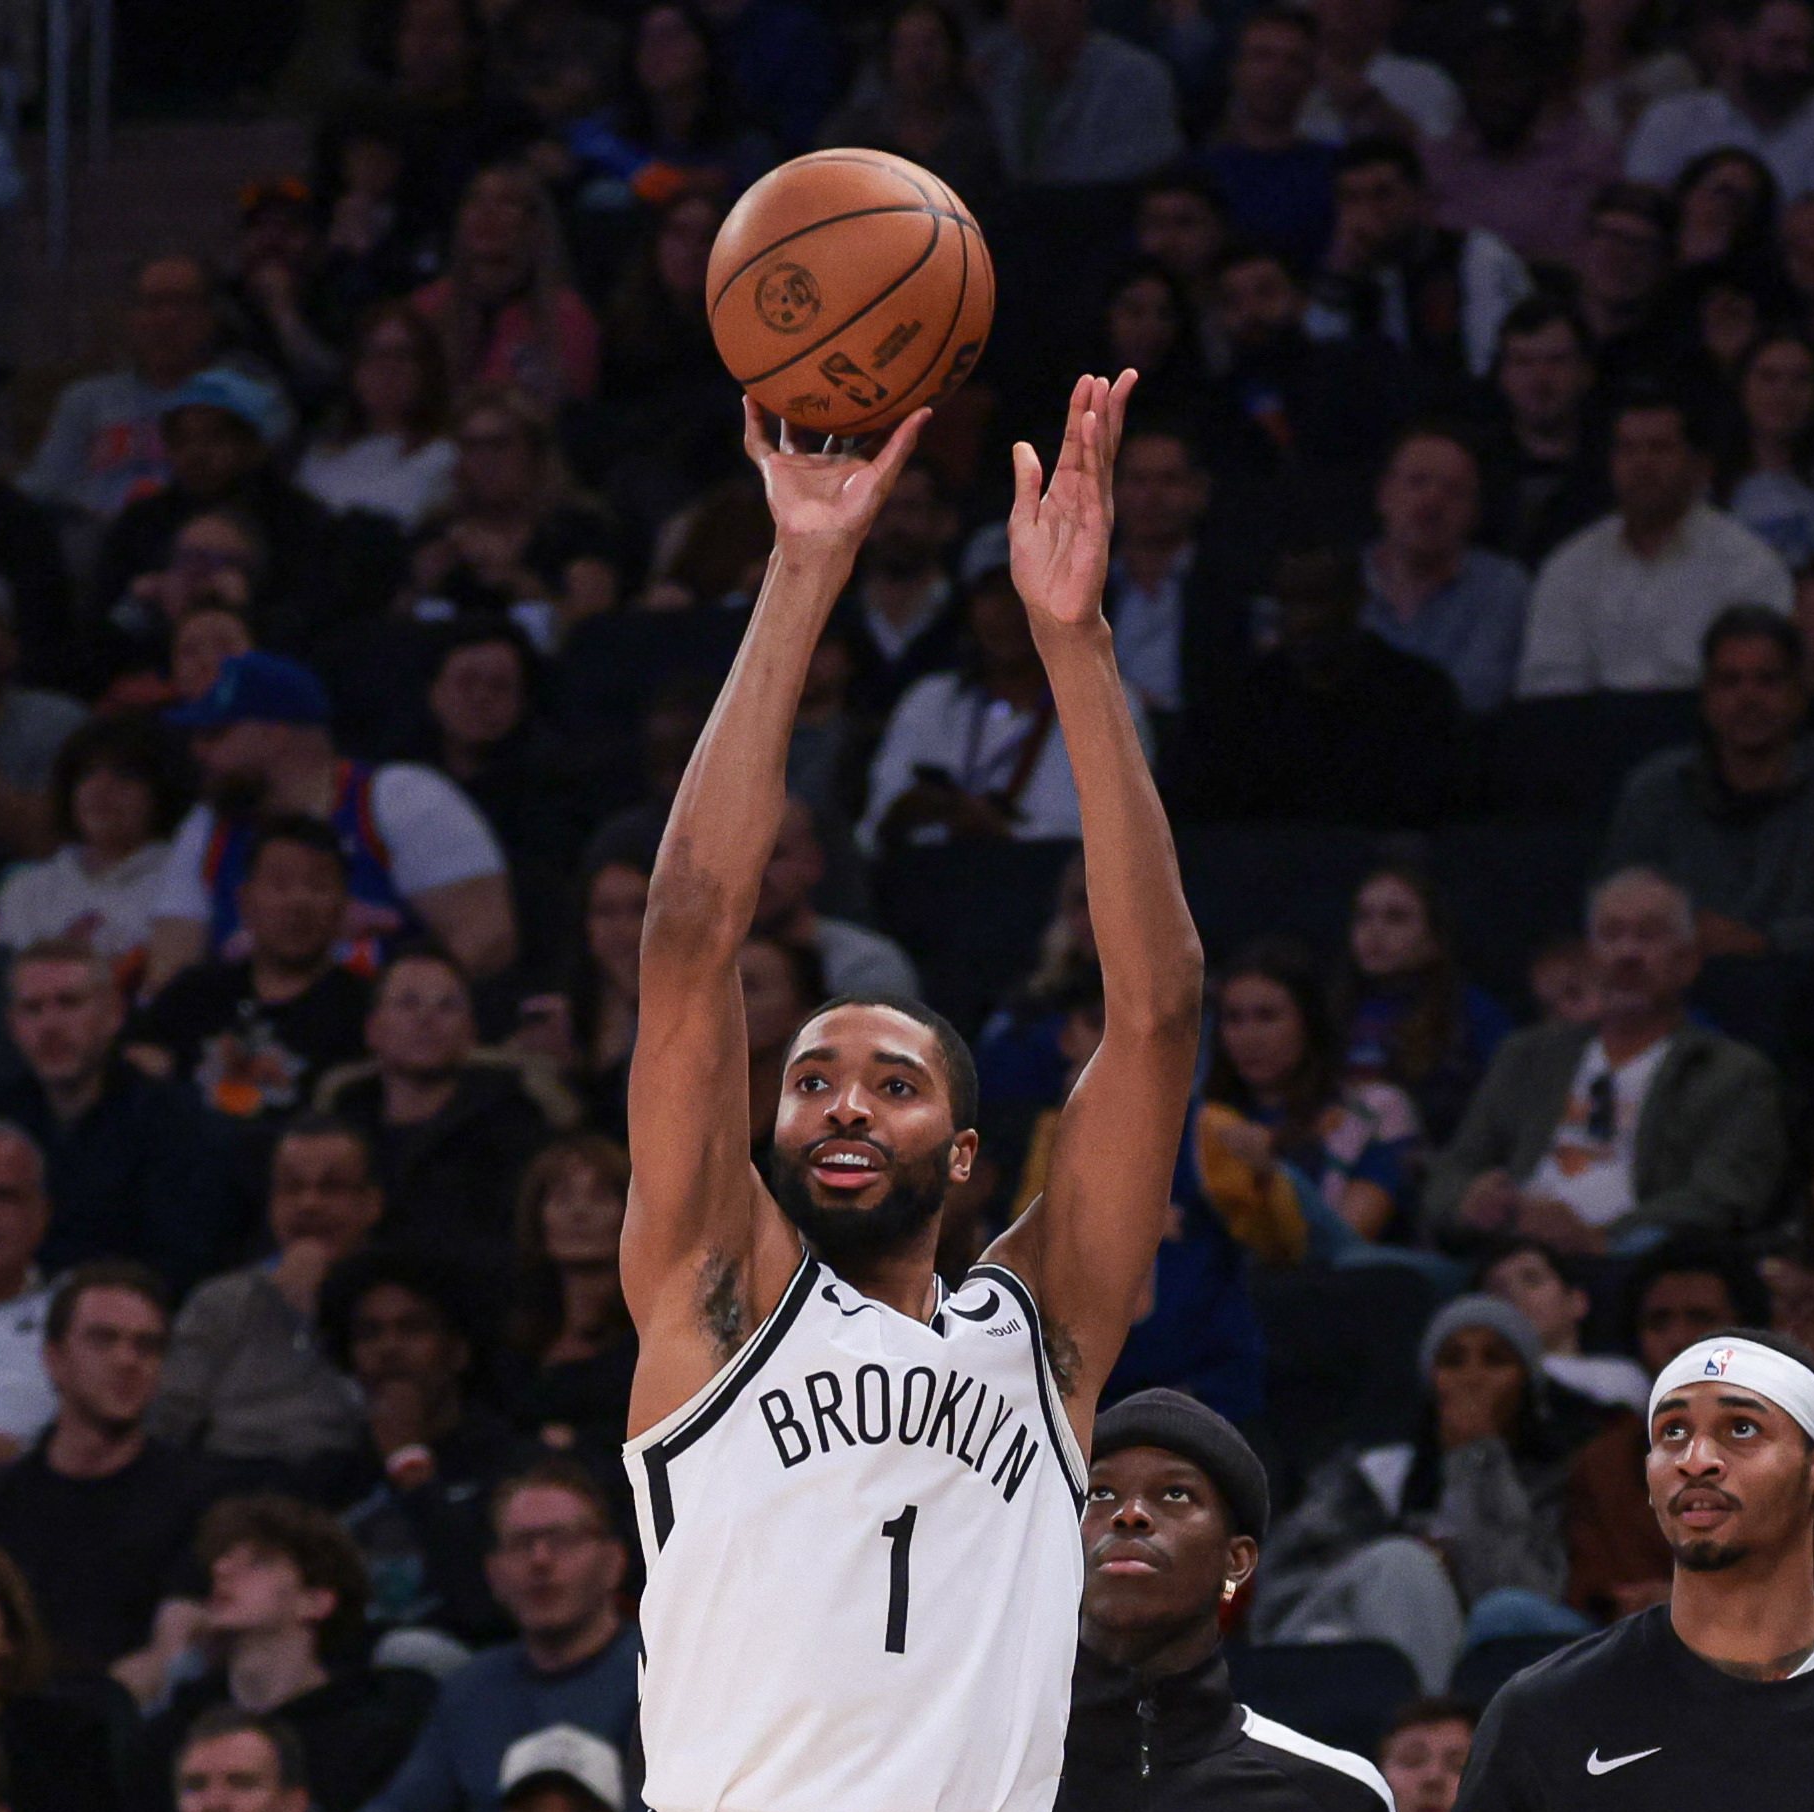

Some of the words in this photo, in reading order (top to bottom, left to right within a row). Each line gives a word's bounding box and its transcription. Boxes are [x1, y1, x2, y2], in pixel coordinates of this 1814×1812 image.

[983, 1318, 1022, 1338] ebull
[759, 1364, 1040, 1504] BROOKLYN
[881, 1504, 918, 1655] 1
